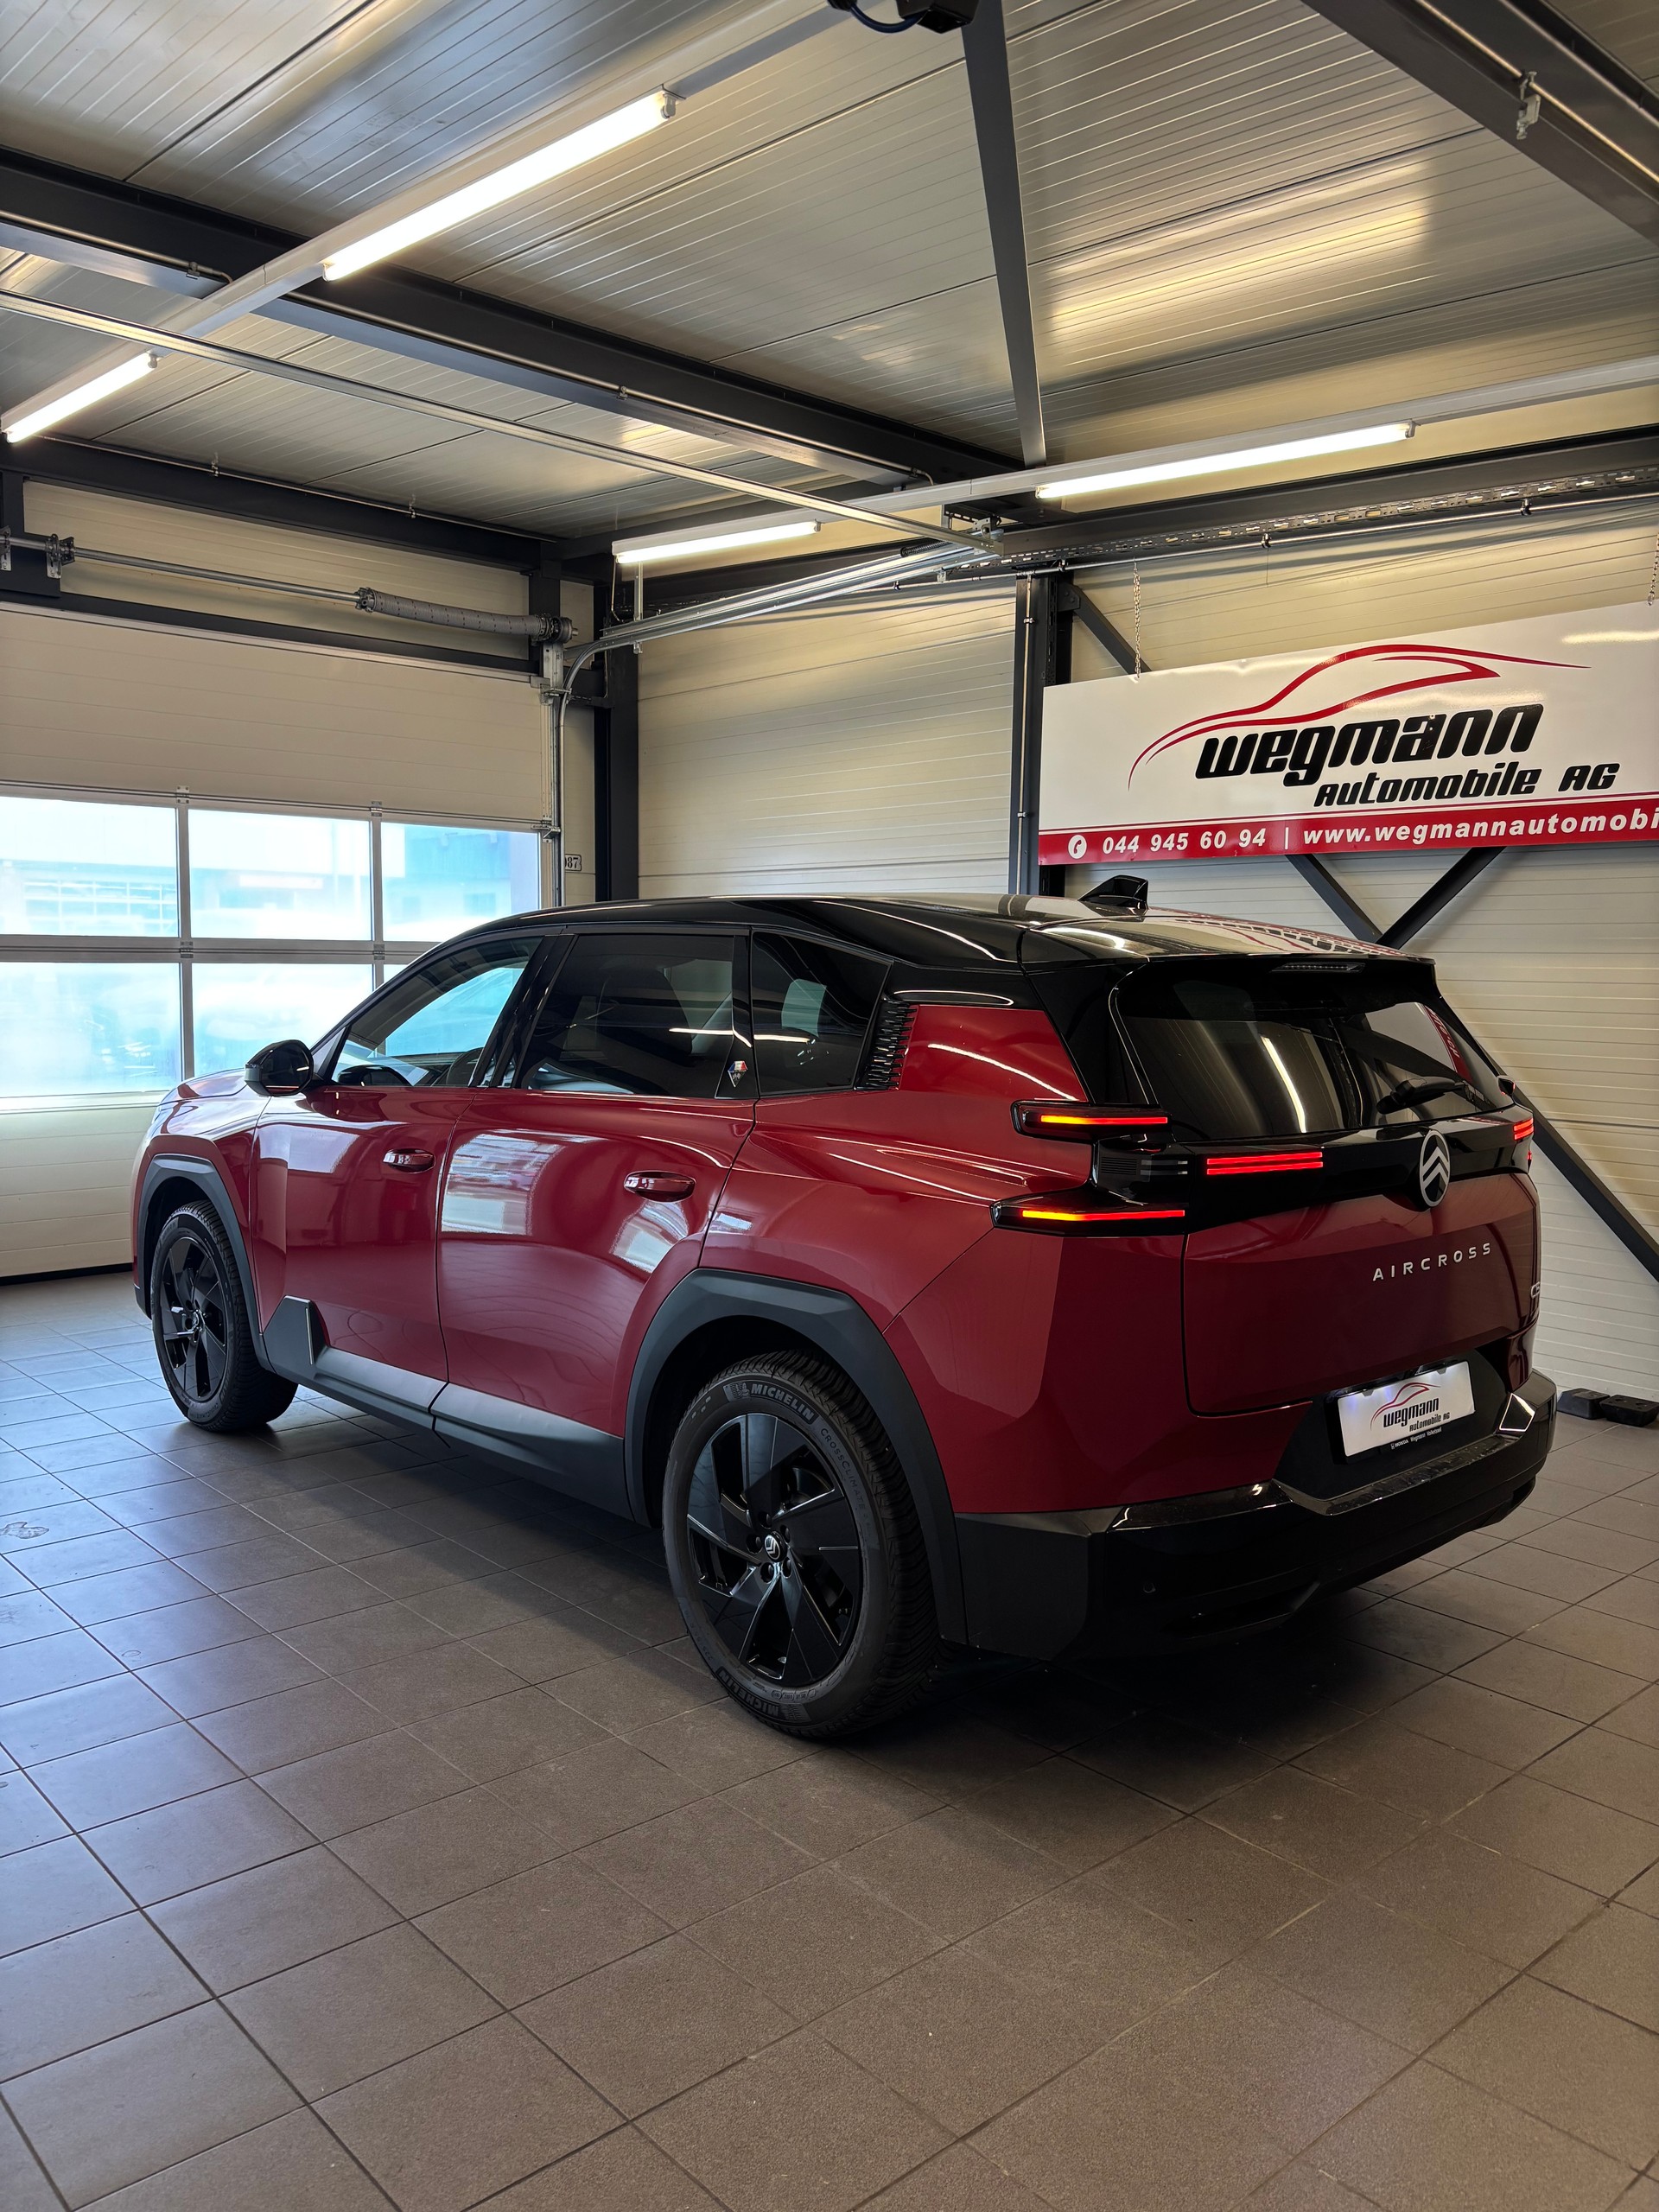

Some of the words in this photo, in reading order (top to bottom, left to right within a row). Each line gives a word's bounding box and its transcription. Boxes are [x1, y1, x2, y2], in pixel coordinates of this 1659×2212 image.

[1195, 704, 1545, 787] wegmann
[1558, 763, 1621, 792] AG
[1103, 835, 1140, 855] 044
[1150, 832, 1189, 852] 945
[1199, 830, 1227, 849] 60
[1238, 828, 1267, 848] 94
[1303, 807, 1659, 844] www.wegmannautomobi
[1372, 1243, 1492, 1282] AIRCROSS
[750, 1383, 815, 1421] MICHELIN
[1382, 1397, 1440, 1428] wegmann
[1442, 1412, 1451, 1421] AG
[716, 1669, 780, 1715] MICHELIN
